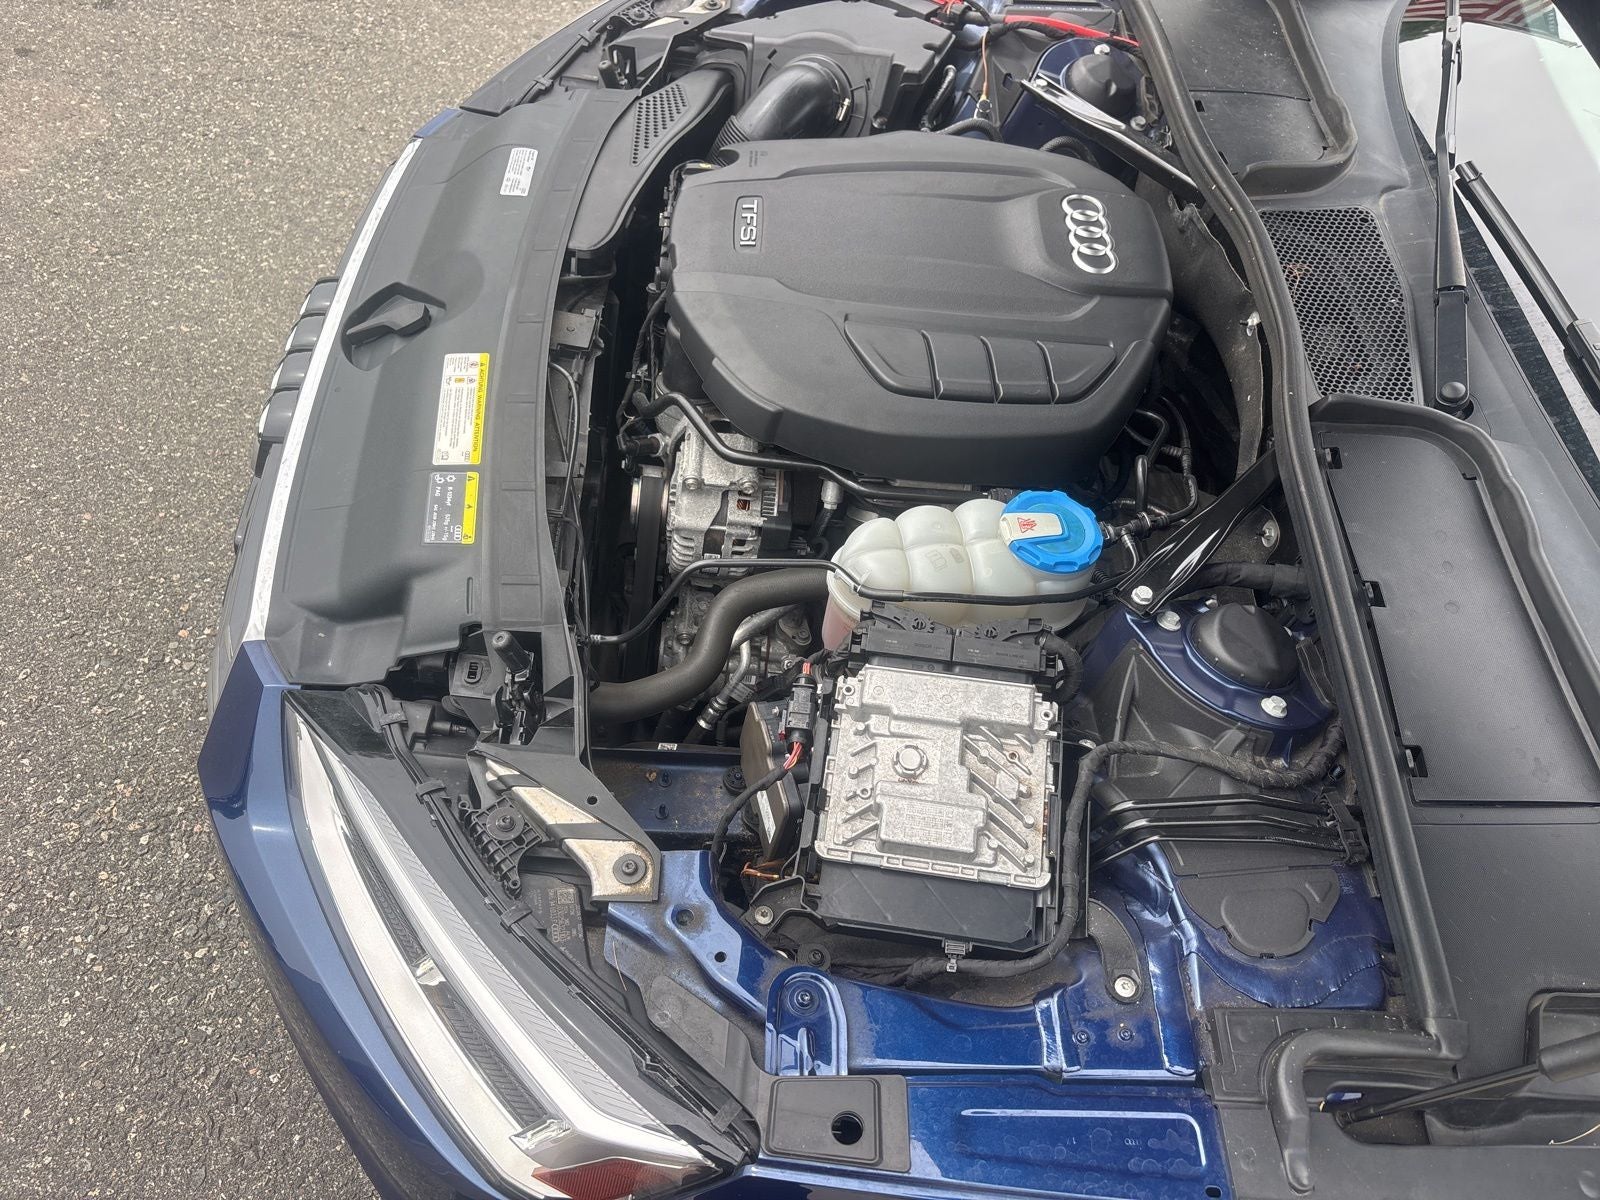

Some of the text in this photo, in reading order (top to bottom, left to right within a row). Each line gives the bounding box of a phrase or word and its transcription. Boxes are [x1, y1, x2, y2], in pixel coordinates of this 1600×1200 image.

[740, 200, 758, 246] TFSI
[472, 369, 486, 452] ACHTUNG WARNING ATTENTION
